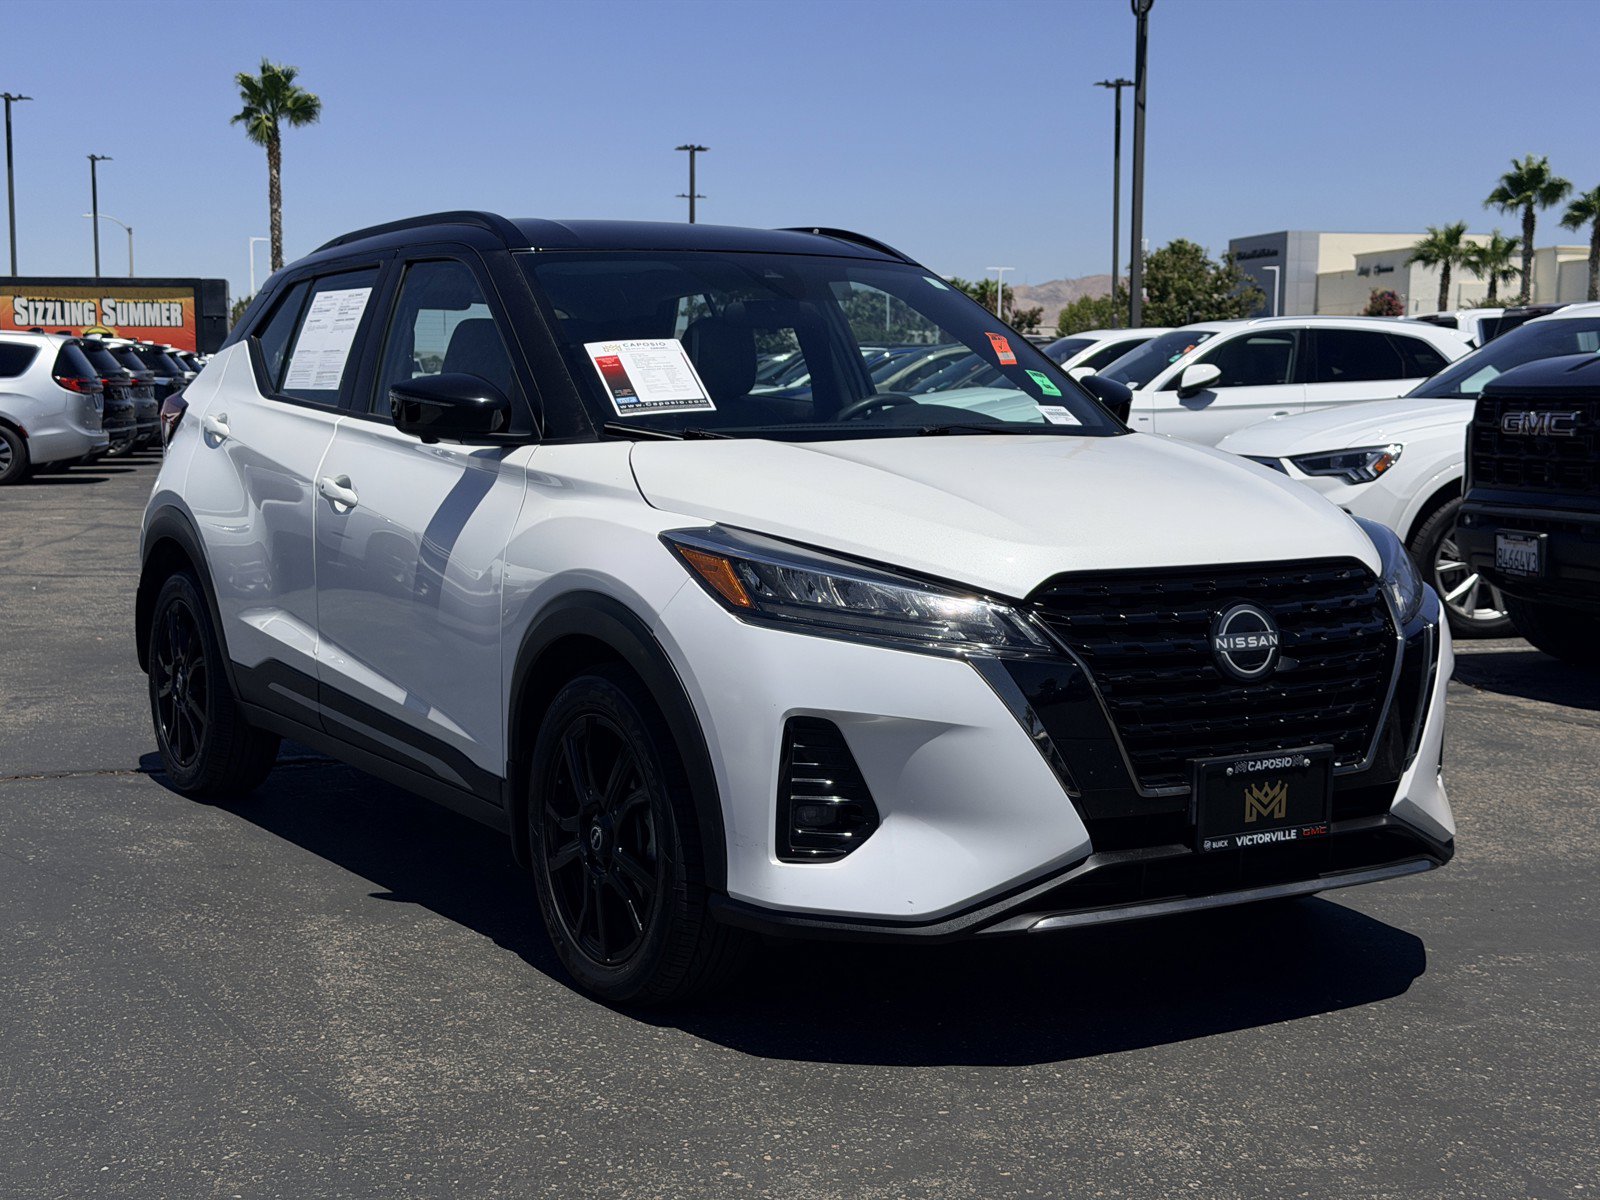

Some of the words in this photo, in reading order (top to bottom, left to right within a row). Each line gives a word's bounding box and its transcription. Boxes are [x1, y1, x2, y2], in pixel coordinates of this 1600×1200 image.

[13, 296, 97, 327] SIZZLING
[100, 297, 184, 327] SUMMER
[1501, 411, 1579, 437] GMC
[1215, 634, 1279, 649] NISSAN
[1247, 757, 1293, 772] CAPOSIO
[1212, 840, 1229, 849] BUICK
[1235, 829, 1298, 847] VICTORVILLE
[1302, 825, 1328, 836] GMC
